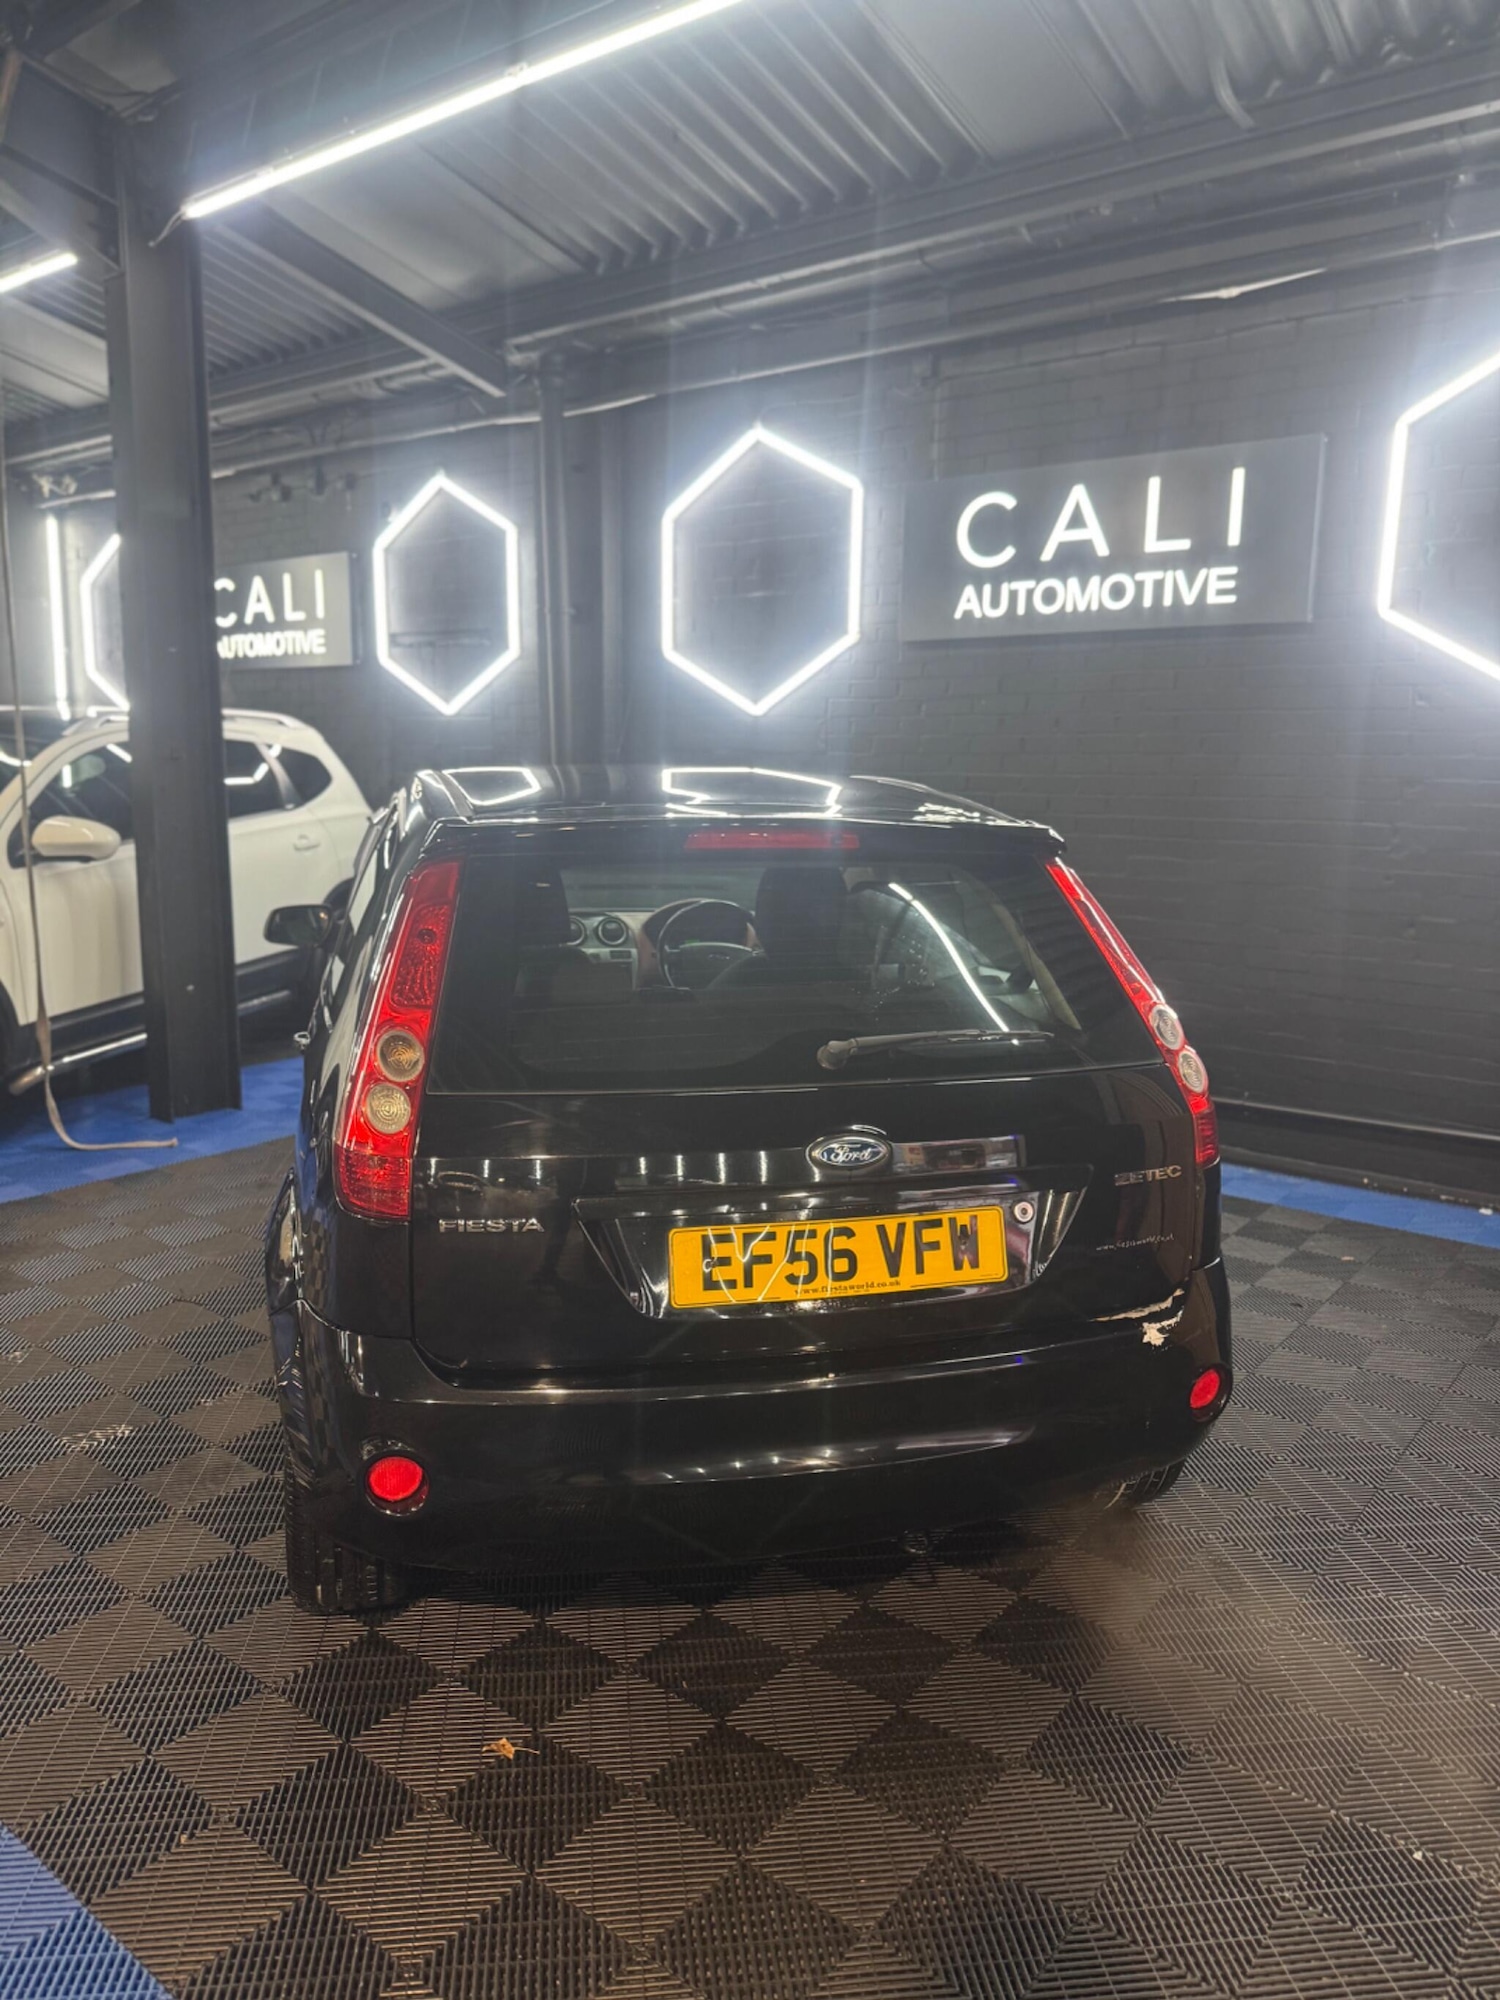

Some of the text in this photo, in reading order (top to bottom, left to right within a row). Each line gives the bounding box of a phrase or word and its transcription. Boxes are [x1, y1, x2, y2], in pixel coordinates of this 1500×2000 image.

[956, 466, 1247, 569] CALI
[214, 568, 326, 628] CALI
[954, 565, 1240, 621] AUTOMOTIVE
[829, 1142, 873, 1164] Ford
[1114, 1165, 1182, 1187] ZETEC
[438, 1217, 545, 1233] FIESTA
[701, 1214, 981, 1292] EF56 VFW
